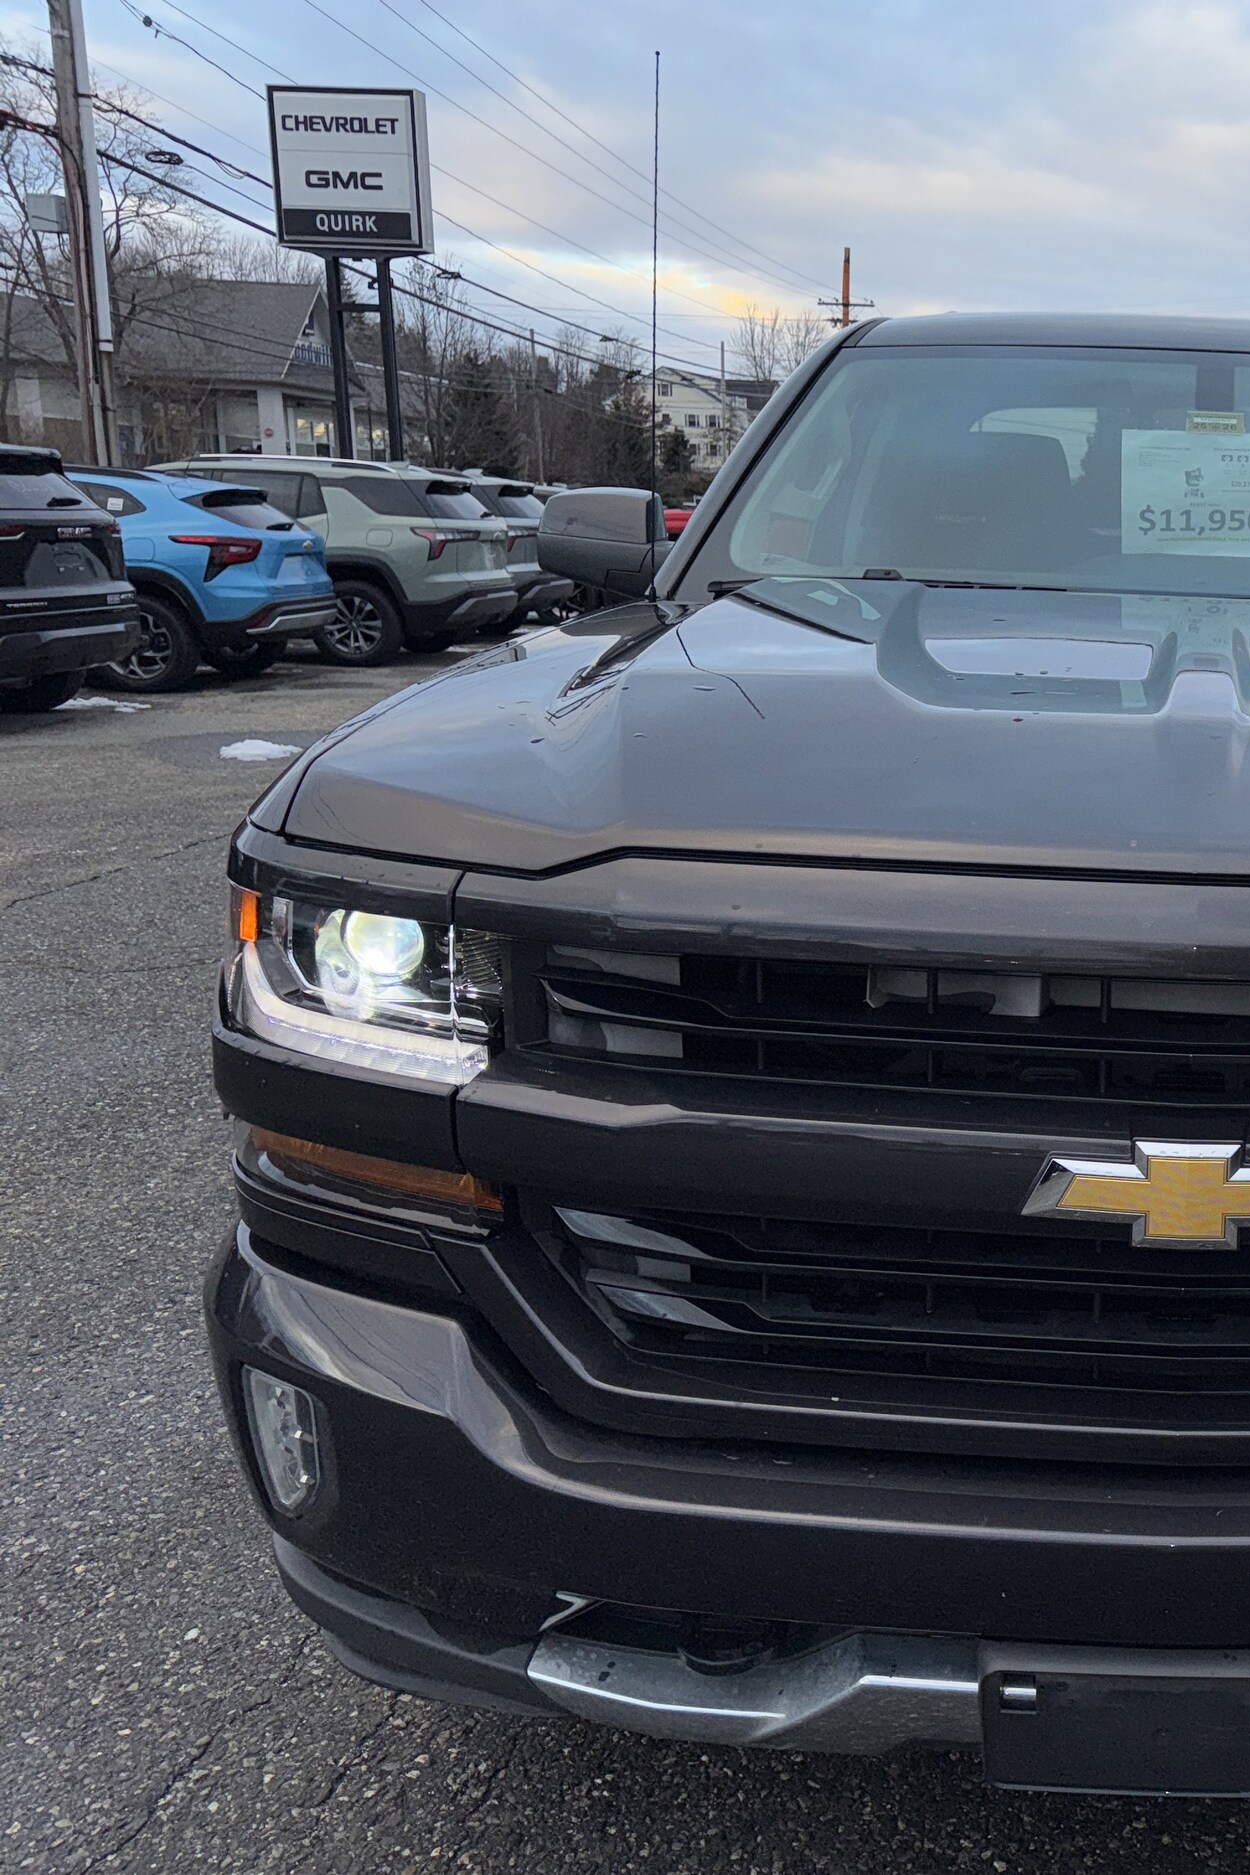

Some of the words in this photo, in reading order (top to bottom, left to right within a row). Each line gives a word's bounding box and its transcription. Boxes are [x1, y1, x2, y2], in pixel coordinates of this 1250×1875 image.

[281, 114, 399, 134] CHEVROLET
[305, 170, 383, 190] GMC
[315, 213, 378, 232] QUIRK
